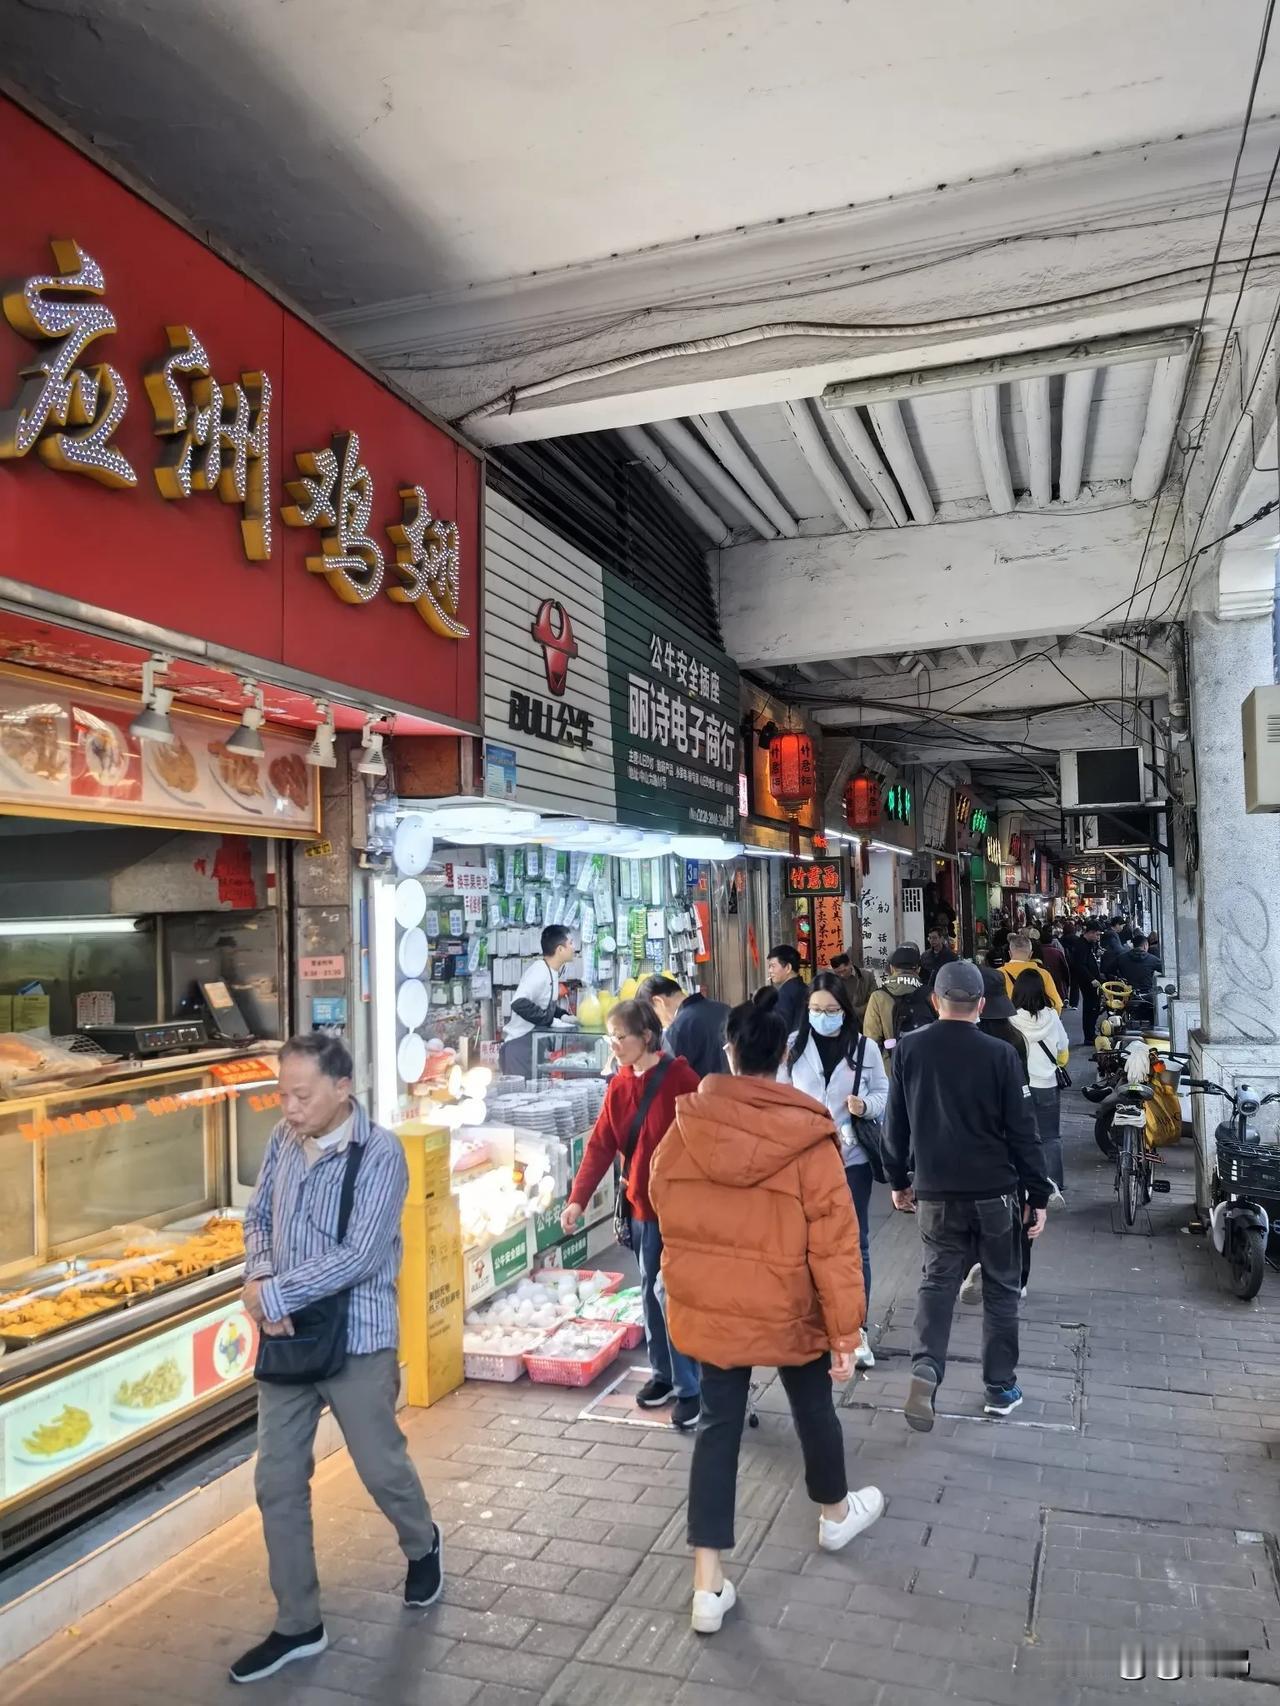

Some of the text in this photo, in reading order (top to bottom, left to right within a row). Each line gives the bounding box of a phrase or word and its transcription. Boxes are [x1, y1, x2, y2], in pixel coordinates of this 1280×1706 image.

[649, 633, 720, 704] 公牛安全插座
[628, 672, 735, 772] 丽诗电子商行
